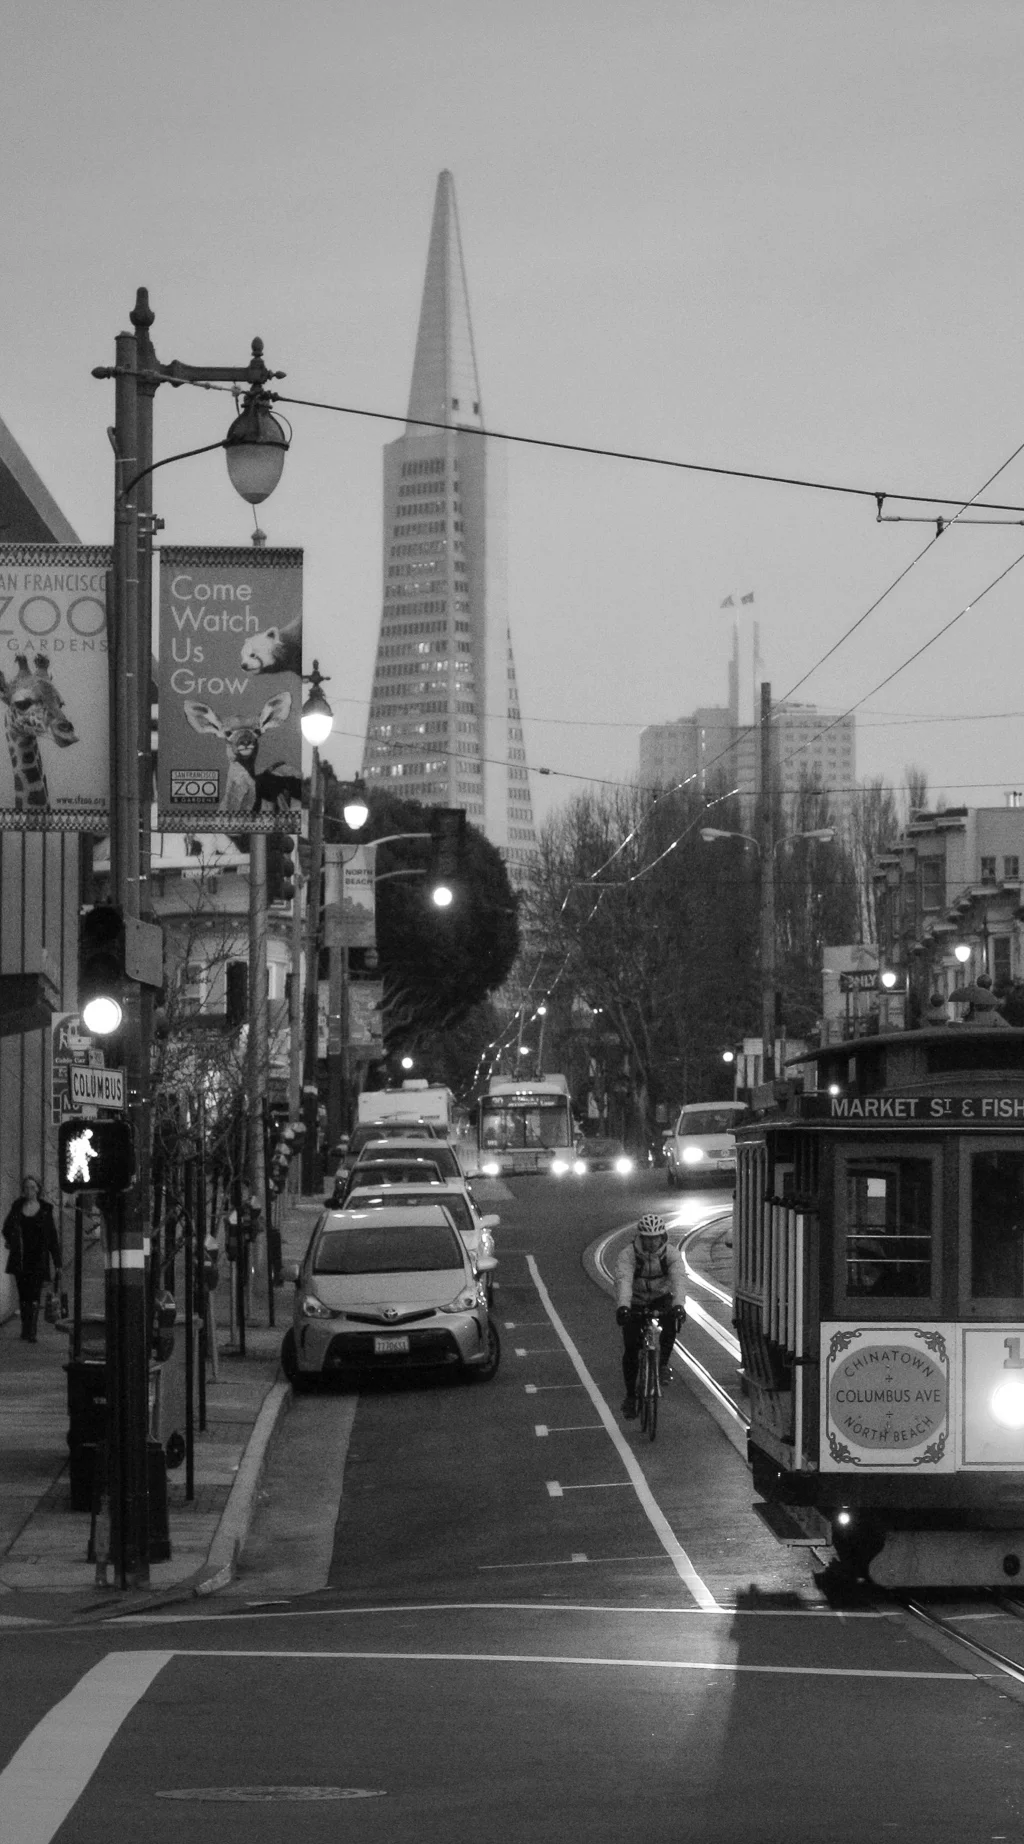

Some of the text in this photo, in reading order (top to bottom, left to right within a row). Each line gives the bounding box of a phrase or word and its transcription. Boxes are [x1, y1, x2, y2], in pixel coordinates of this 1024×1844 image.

[0, 573, 17, 592] AN
[171, 575, 252, 601] Come
[170, 605, 259, 632] Watch
[7, 638, 108, 652] GARDENS
[172, 637, 204, 663] Us
[170, 668, 249, 694] Grow
[174, 781, 217, 796] ZOO
[73, 1072, 122, 1101] COLUMBUS
[831, 1098, 919, 1117] MARKET
[961, 1098, 975, 1117] &
[844, 1350, 934, 1378] CHINATOWN
[836, 1389, 941, 1403] COLUMBUS AVE
[843, 1416, 934, 1442] NORTH BEACH
